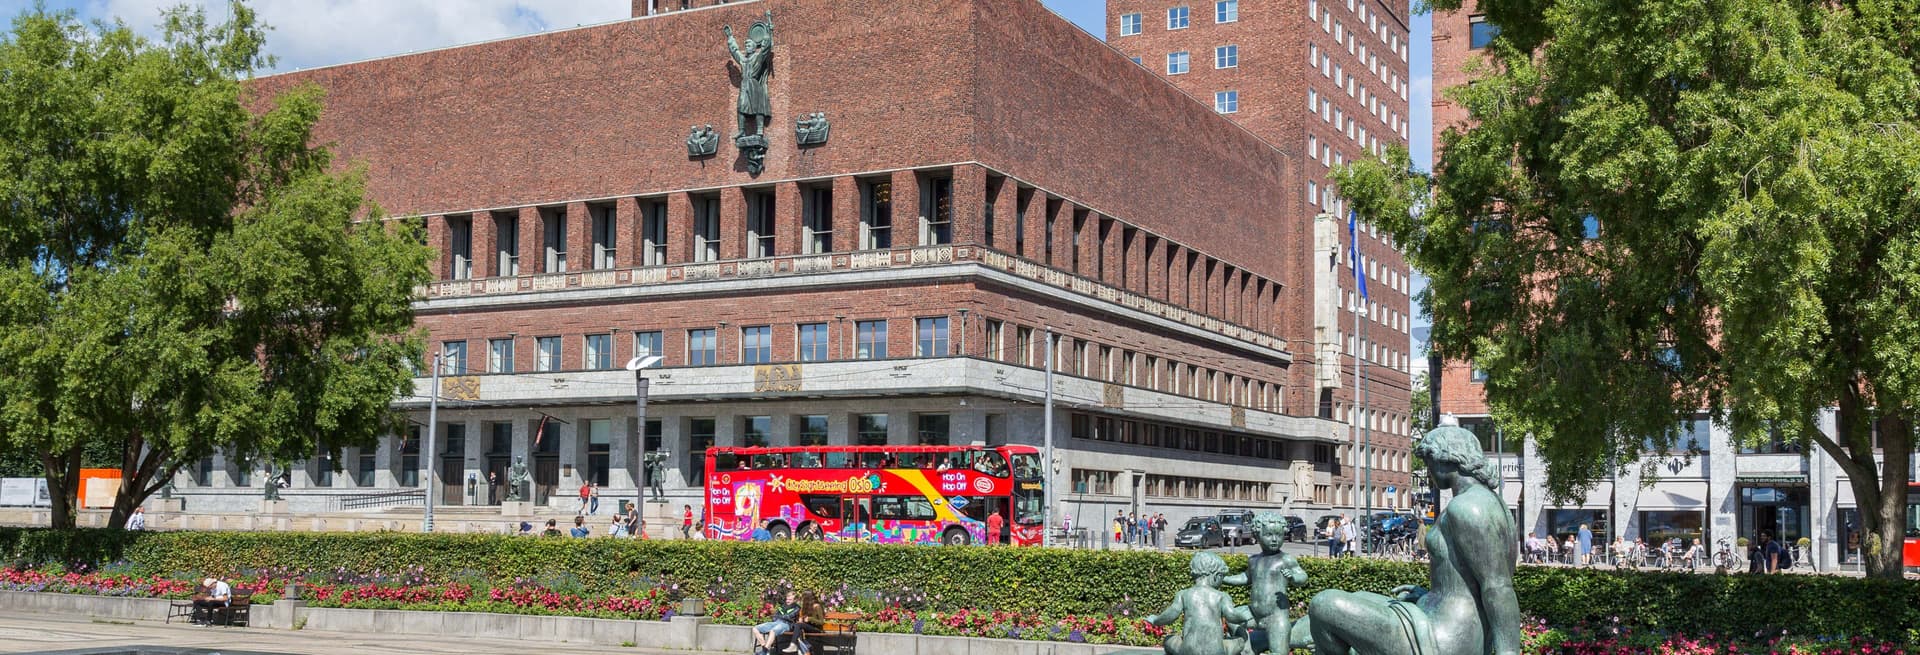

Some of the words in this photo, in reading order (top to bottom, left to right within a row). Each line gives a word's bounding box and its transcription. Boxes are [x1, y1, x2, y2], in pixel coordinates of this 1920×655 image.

[942, 473, 955, 482] Hop
[956, 472, 966, 481] On
[848, 477, 872, 493] Oslo
[942, 482, 955, 491] Hop
[956, 482, 967, 491] Off
